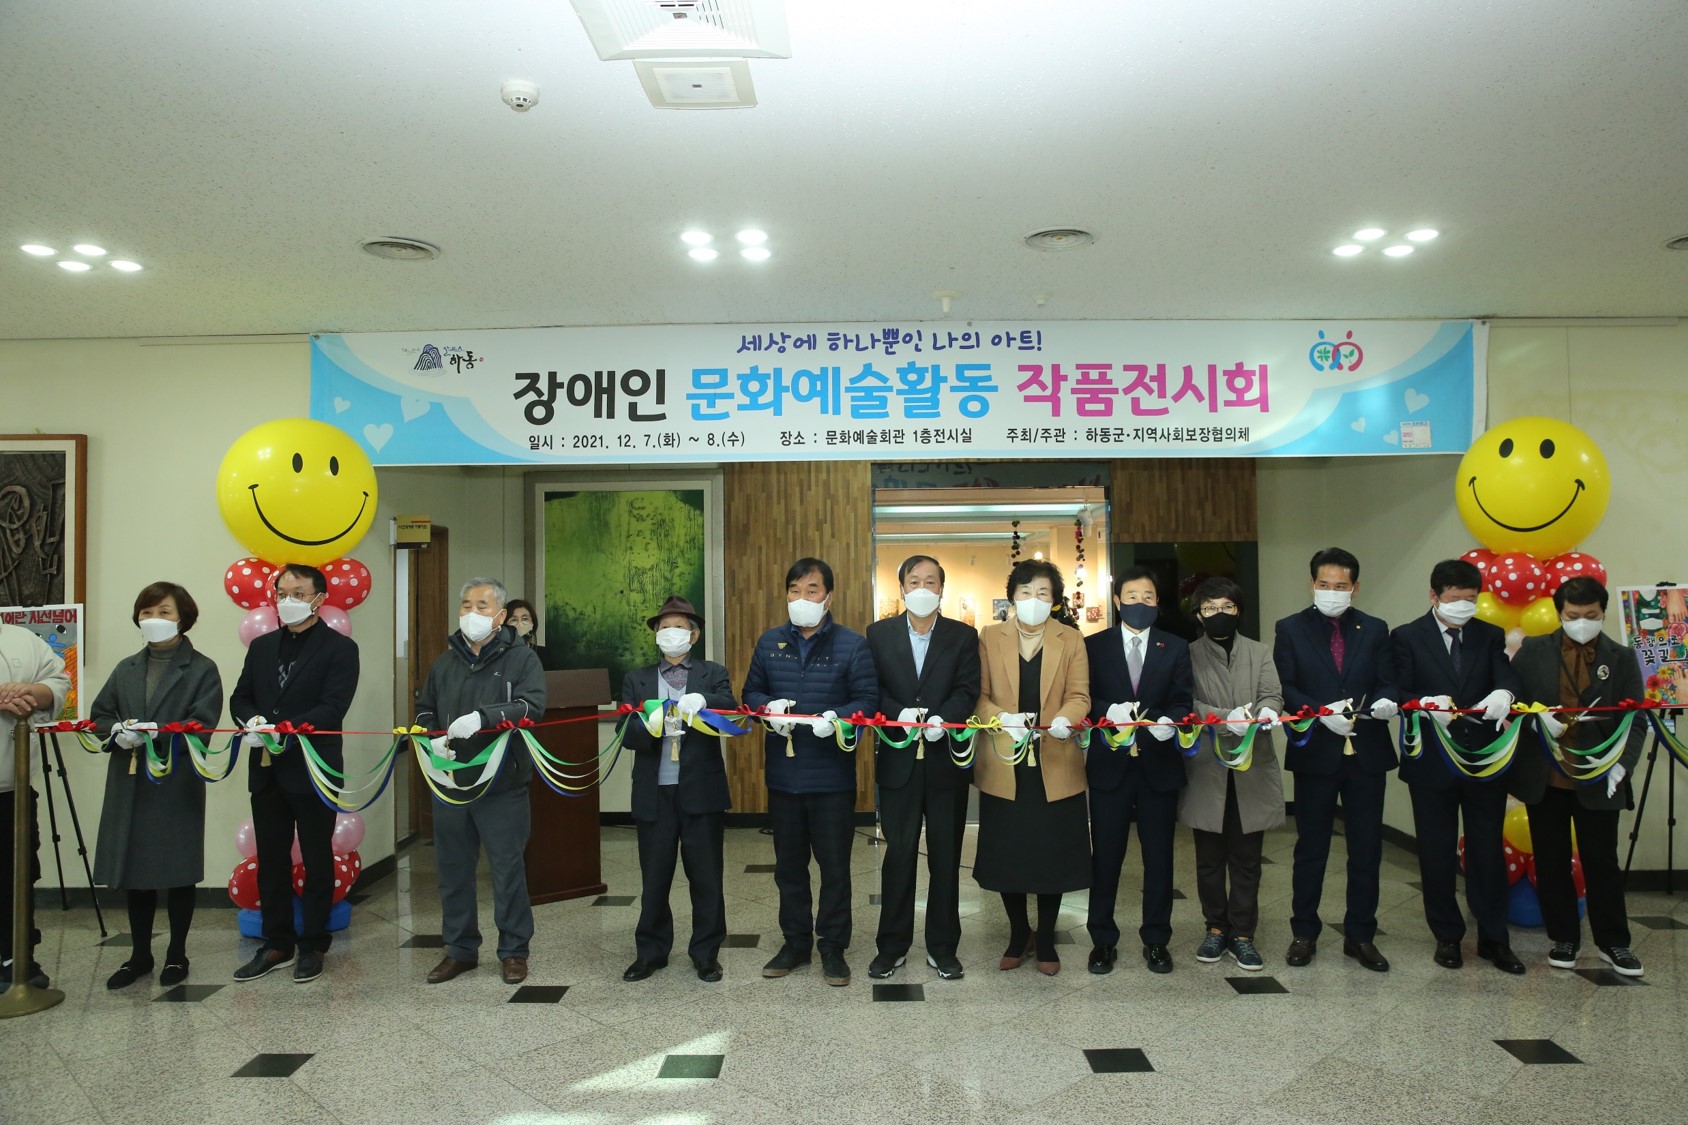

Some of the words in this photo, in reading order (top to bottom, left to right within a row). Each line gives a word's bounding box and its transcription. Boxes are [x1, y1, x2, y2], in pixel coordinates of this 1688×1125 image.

[737, 331, 817, 354] 세상에
[826, 328, 923, 356] 하나뿐인
[932, 330, 981, 350] 나의
[991, 329, 1042, 351] 아트!
[449, 350, 478, 374] 하동
[513, 369, 667, 426] 장애인
[686, 361, 998, 421] 문화예술활동
[1016, 361, 1270, 418] 작품전시회
[528, 434, 553, 450] 일시
[572, 434, 609, 449] 2021.
[616, 433, 636, 448] 12.
[643, 432, 681, 448] 7.(화)
[706, 431, 746, 447] 8.(수)
[779, 430, 806, 446] 장소
[825, 429, 906, 445] 문화예술회관
[912, 427, 973, 444] 1층전시실
[1006, 427, 1066, 443] 주최/주관
